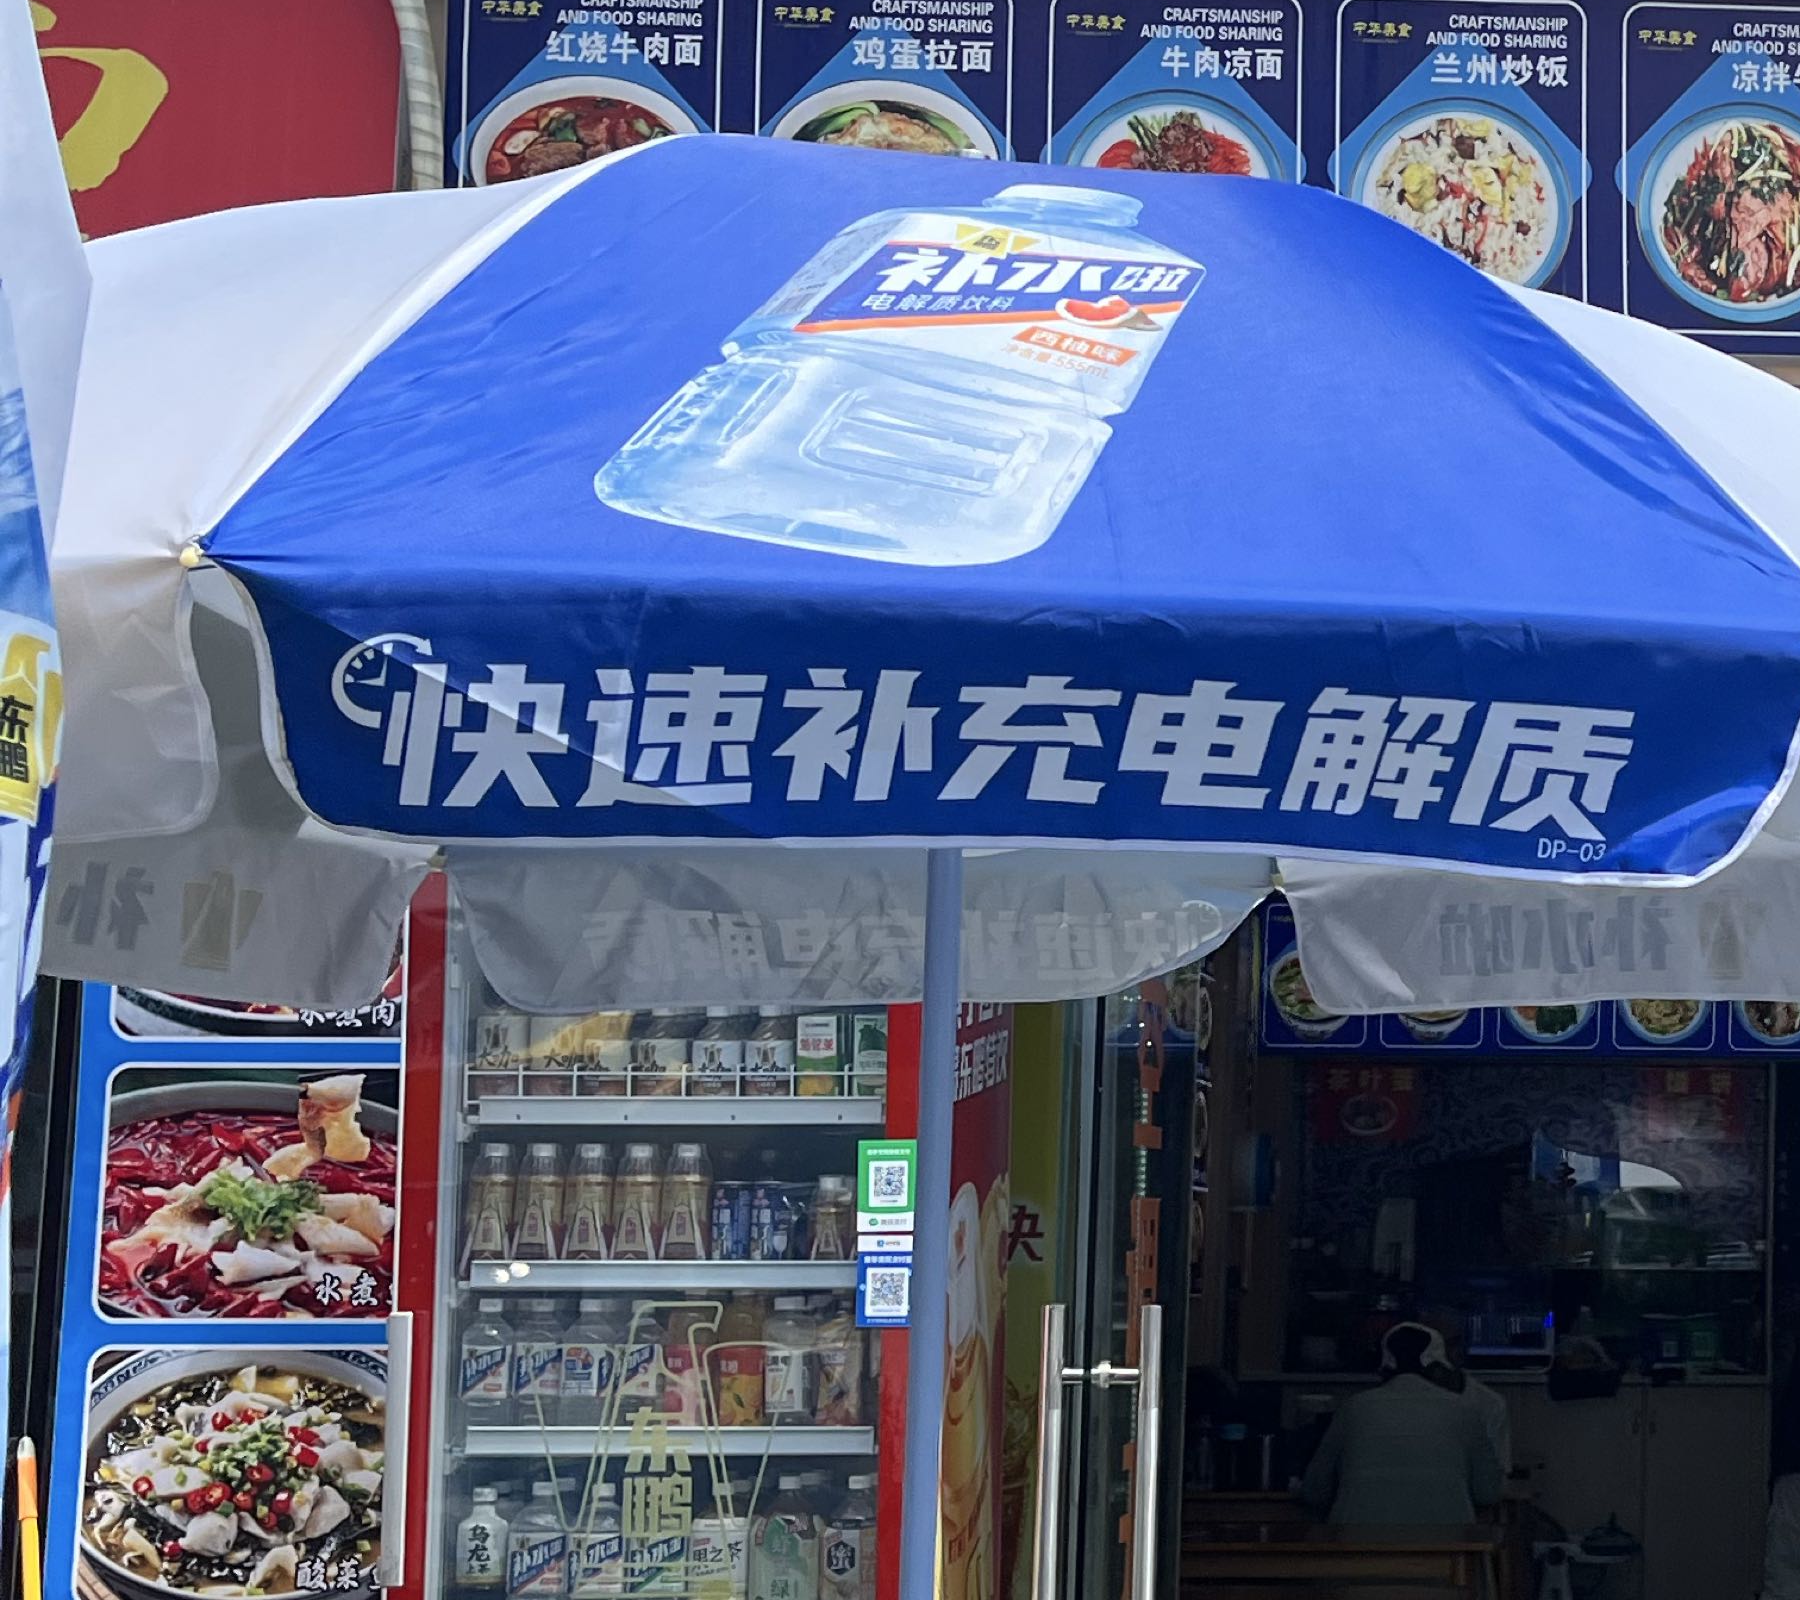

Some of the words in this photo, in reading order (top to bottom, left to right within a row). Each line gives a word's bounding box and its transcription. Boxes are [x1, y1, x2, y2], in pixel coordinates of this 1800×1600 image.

[557, 9, 590, 25] AND
[593, 10, 634, 26] FOOD
[636, 11, 703, 28] SHARING
[849, 16, 882, 31] AND
[884, 17, 926, 33] FOOD
[928, 18, 994, 35] SHARING
[1163, 7, 1285, 25] CRAFTSMANSHIP
[1449, 14, 1569, 32] CRAFTSMANSHIP
[545, 30, 704, 67] 红烧牛肉面
[1140, 24, 1173, 39] AND
[1175, 25, 1216, 41] FOOD
[1218, 26, 1284, 42] SHARING
[1426, 31, 1458, 46] AND
[1461, 32, 1502, 48] FOOD
[1504, 33, 1568, 50] SHARING
[1711, 39, 1743, 54] AND
[1746, 40, 1785, 56] FOOD
[851, 37, 994, 73] 鸡蛋拉面
[1160, 46, 1285, 82] 牛肉凉面
[1429, 52, 1570, 89] 兰州炒饭
[877, 248, 1191, 294] 补水啦
[861, 292, 1016, 312] 电解质饮料
[382, 662, 1636, 842] 快速补充电解质
[1536, 836, 1607, 864] DP-03
[315, 1270, 393, 1307] 水煮
[624, 1405, 693, 1539] 东鹏
[467, 1523, 491, 1563] 乌龙
